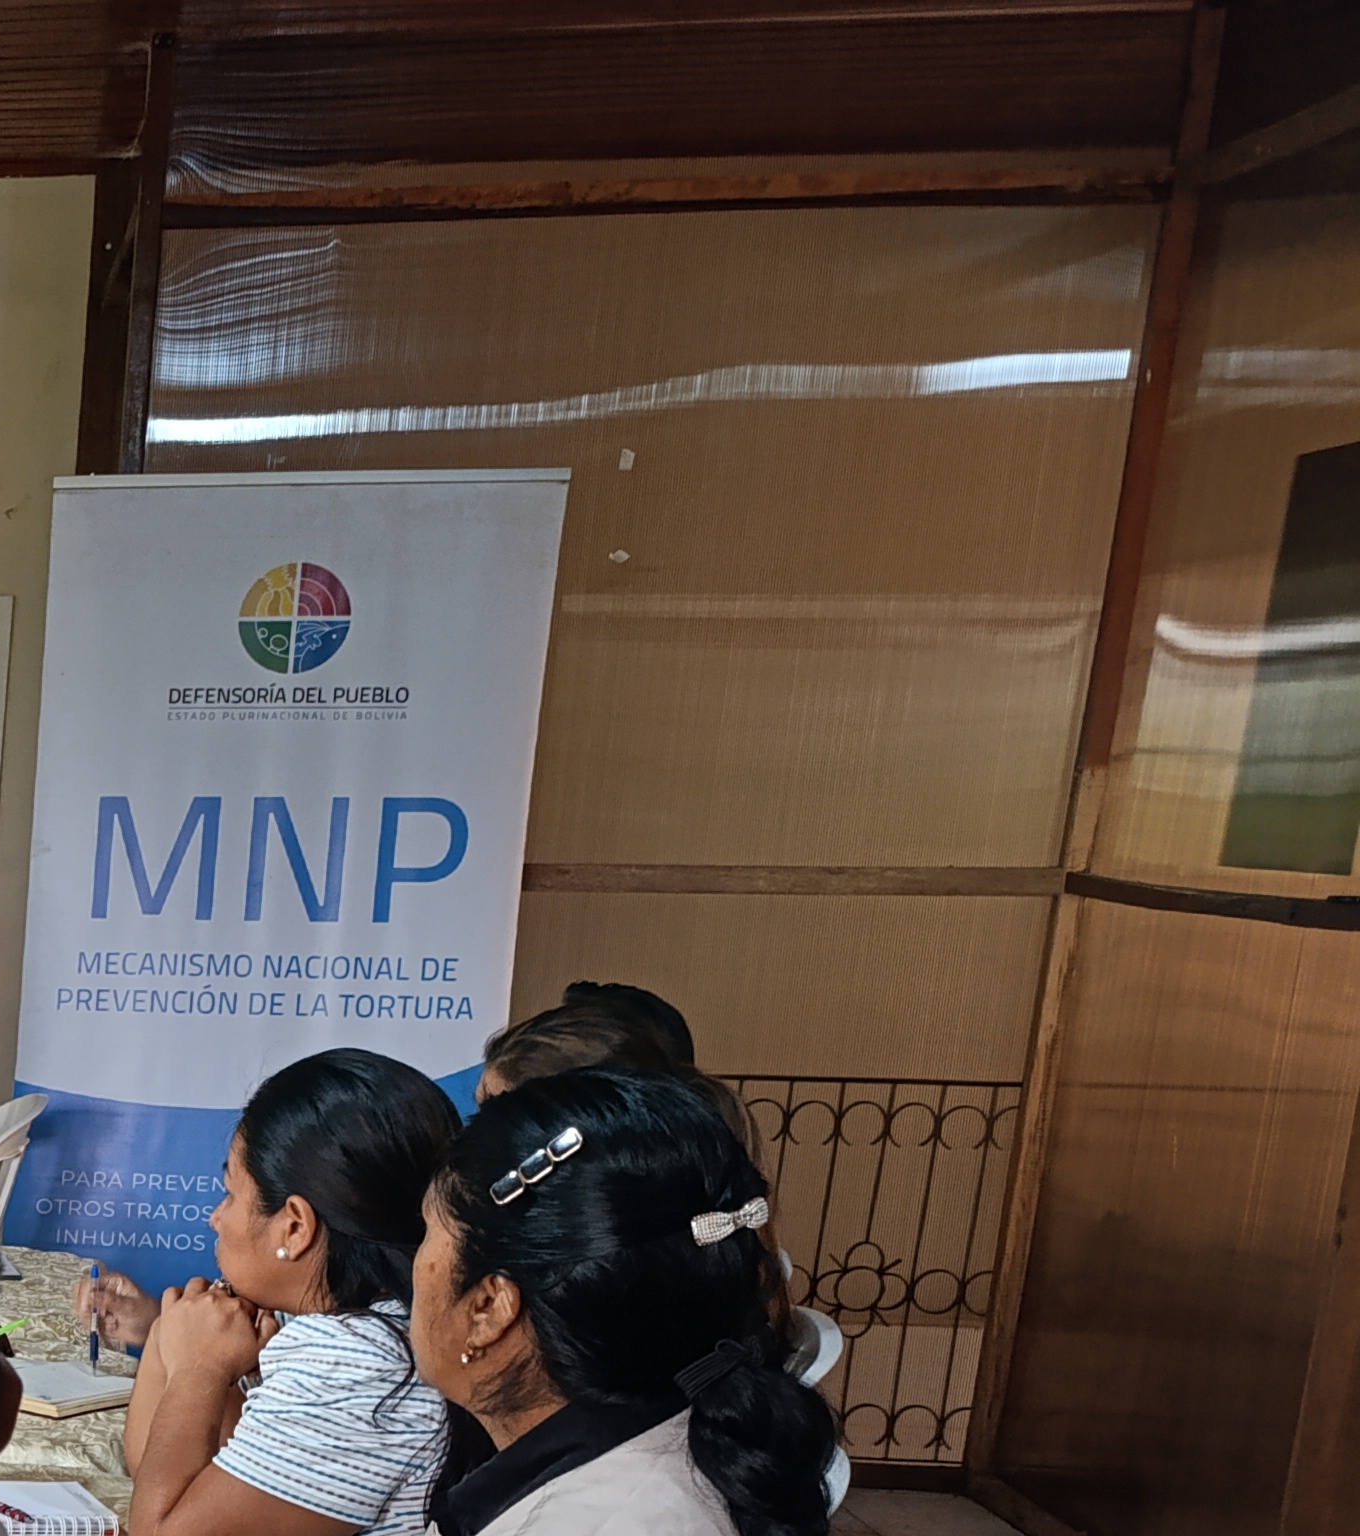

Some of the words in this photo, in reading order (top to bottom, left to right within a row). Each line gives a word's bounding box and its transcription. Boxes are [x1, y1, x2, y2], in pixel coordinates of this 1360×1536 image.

[168, 682, 286, 704] DEFENSORÍA
[292, 686, 327, 704] DEL
[332, 686, 410, 704] PUEBLO
[167, 711, 216, 721] ESTADO
[222, 711, 326, 721] PLURINACIONAL
[332, 711, 348, 721] DE
[355, 711, 408, 721] BOLIVIA
[91, 795, 469, 923] MNP
[76, 951, 254, 978] MECANISMO
[262, 954, 410, 981] NACIONAL
[420, 957, 459, 982] DE
[55, 985, 238, 1015] PREVENCIÓN
[248, 992, 286, 1016] DE
[295, 993, 329, 1017] LA
[338, 994, 474, 1020] TORTURA
[61, 1170, 123, 1188] PARA
[36, 1198, 115, 1217] OTROS
[123, 1202, 212, 1222] TRATOS
[55, 1228, 206, 1251] INHUMANOS
